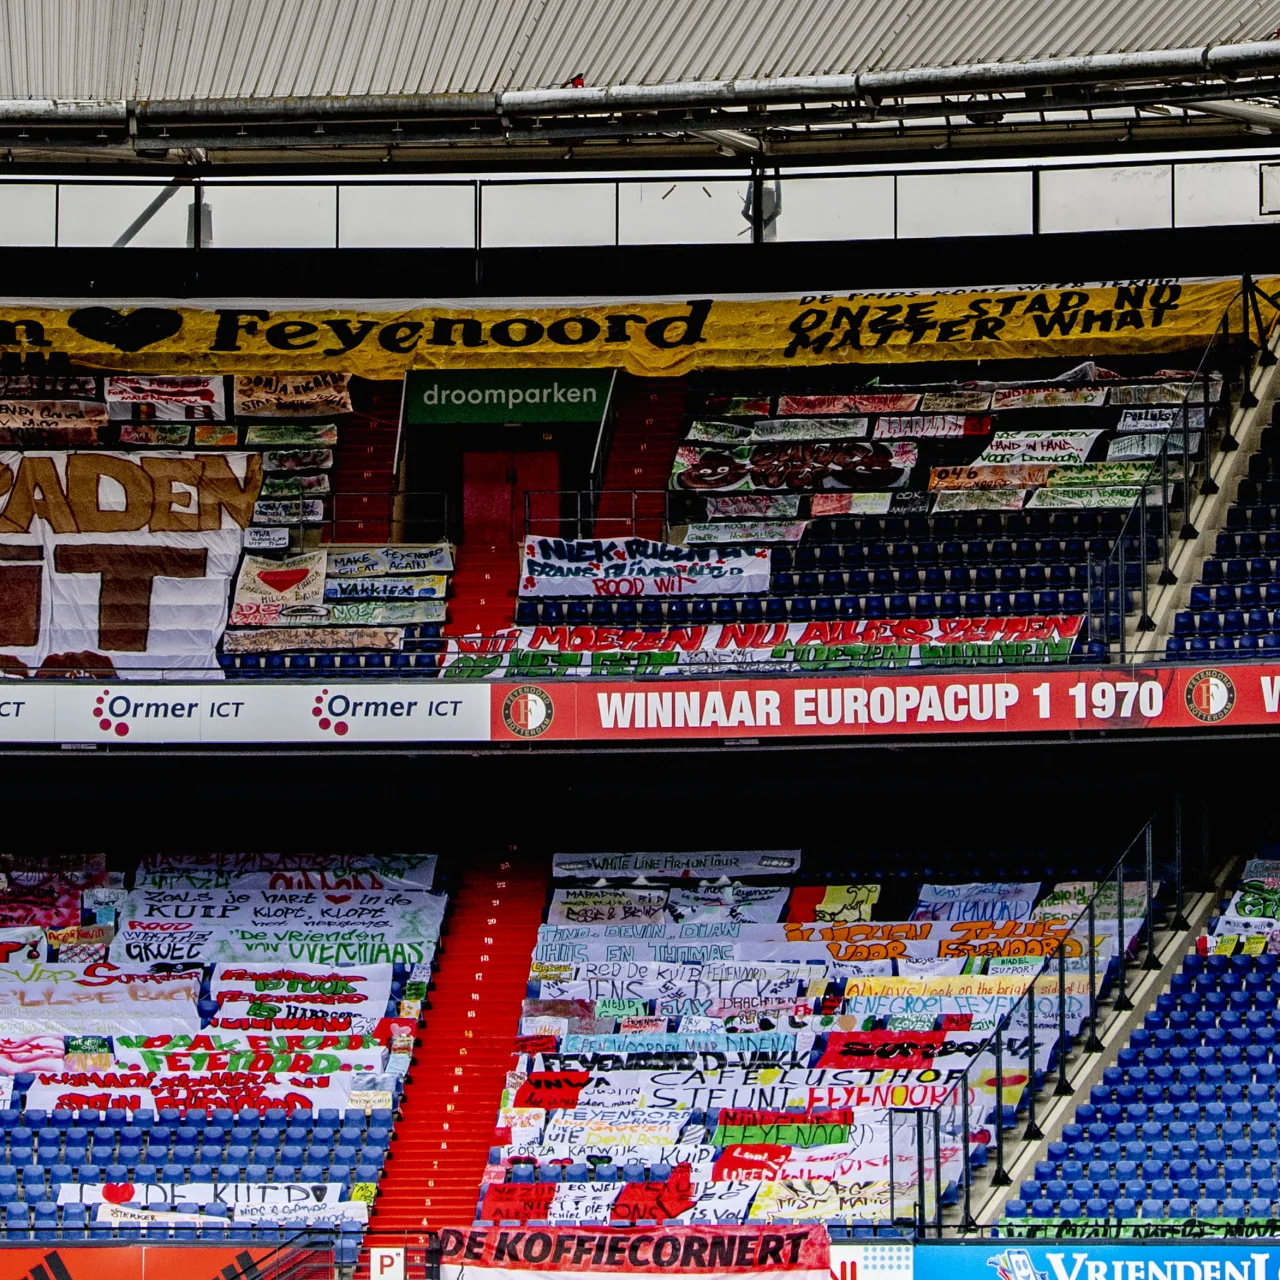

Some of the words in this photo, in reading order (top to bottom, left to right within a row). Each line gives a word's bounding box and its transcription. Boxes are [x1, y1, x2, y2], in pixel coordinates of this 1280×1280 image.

[786, 302, 941, 334] ONZE
[966, 291, 1089, 320] STAD
[209, 299, 714, 357] Feyenoord
[784, 318, 1007, 358] MATTER
[1033, 308, 1174, 338] WHAT
[423, 383, 598, 409] droomparken
[333, 554, 373, 567] MAKE
[538, 540, 618, 562] NIEK
[388, 559, 427, 571] AGAIN
[592, 578, 645, 595] ROOD
[527, 625, 709, 653] MOETEN
[717, 623, 787, 652] NU
[1187, 669, 1234, 697] FEYENOORD
[107, 695, 199, 719] Ormer
[209, 701, 245, 718] ICT
[327, 693, 418, 718] Ormer
[427, 700, 463, 717] ICT
[505, 686, 552, 713] FEYENOORD
[596, 689, 782, 730] WINNAAR
[794, 682, 1020, 727] EUROPACUP
[1032, 681, 1052, 719] 1
[1068, 680, 1164, 720] 1970
[1188, 698, 1234, 722] ROTTERDAM
[506, 715, 551, 739] ROTTERDAM
[143, 903, 240, 919] KUIP
[128, 920, 195, 932] ROOD
[949, 918, 1072, 940] THUIS
[606, 945, 635, 963] EN
[826, 941, 909, 960] VOOR
[990, 964, 1039, 975] SUPPORT
[957, 985, 974, 996] on
[976, 981, 994, 996] the
[659, 998, 713, 1017] JAX
[140, 1051, 342, 1074] FEYENOORD
[779, 1069, 962, 1087] LUSTHOF
[649, 1086, 797, 1110] STEUNT
[505, 1144, 557, 1158] FORZA
[568, 1143, 640, 1157] KATWIJK
[439, 1227, 488, 1257] DE
[493, 1229, 809, 1268] KOFFIECORNERT
[379, 1254, 396, 1276] P
